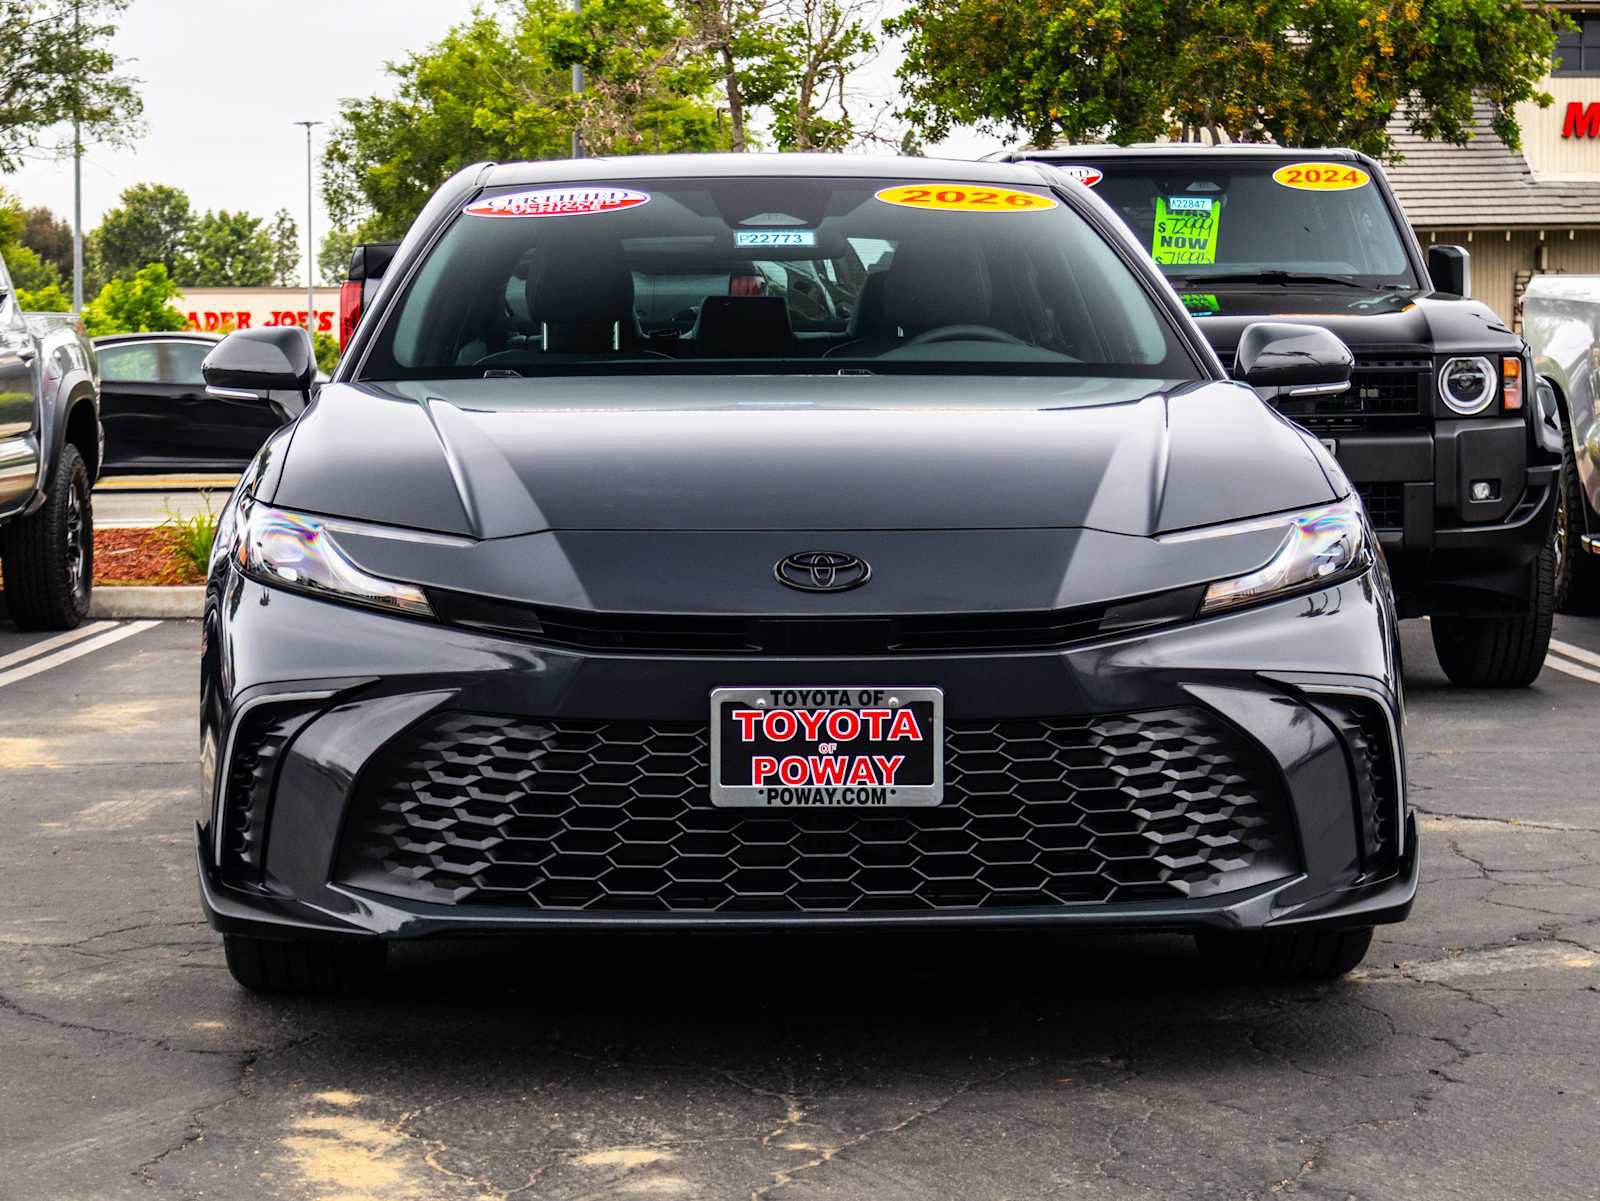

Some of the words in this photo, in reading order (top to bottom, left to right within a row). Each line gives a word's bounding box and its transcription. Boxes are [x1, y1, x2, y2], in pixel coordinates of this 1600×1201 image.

[1286, 169, 1359, 184] 2024
[900, 190, 1034, 206] 2026
[1161, 236, 1208, 250] NOW
[771, 689, 850, 707] TOYOTA
[858, 689, 885, 706] OF
[732, 709, 924, 742] TOYOTA
[818, 743, 837, 755] OF
[752, 755, 905, 787] POWAY
[767, 787, 887, 806] POWAY.COM
